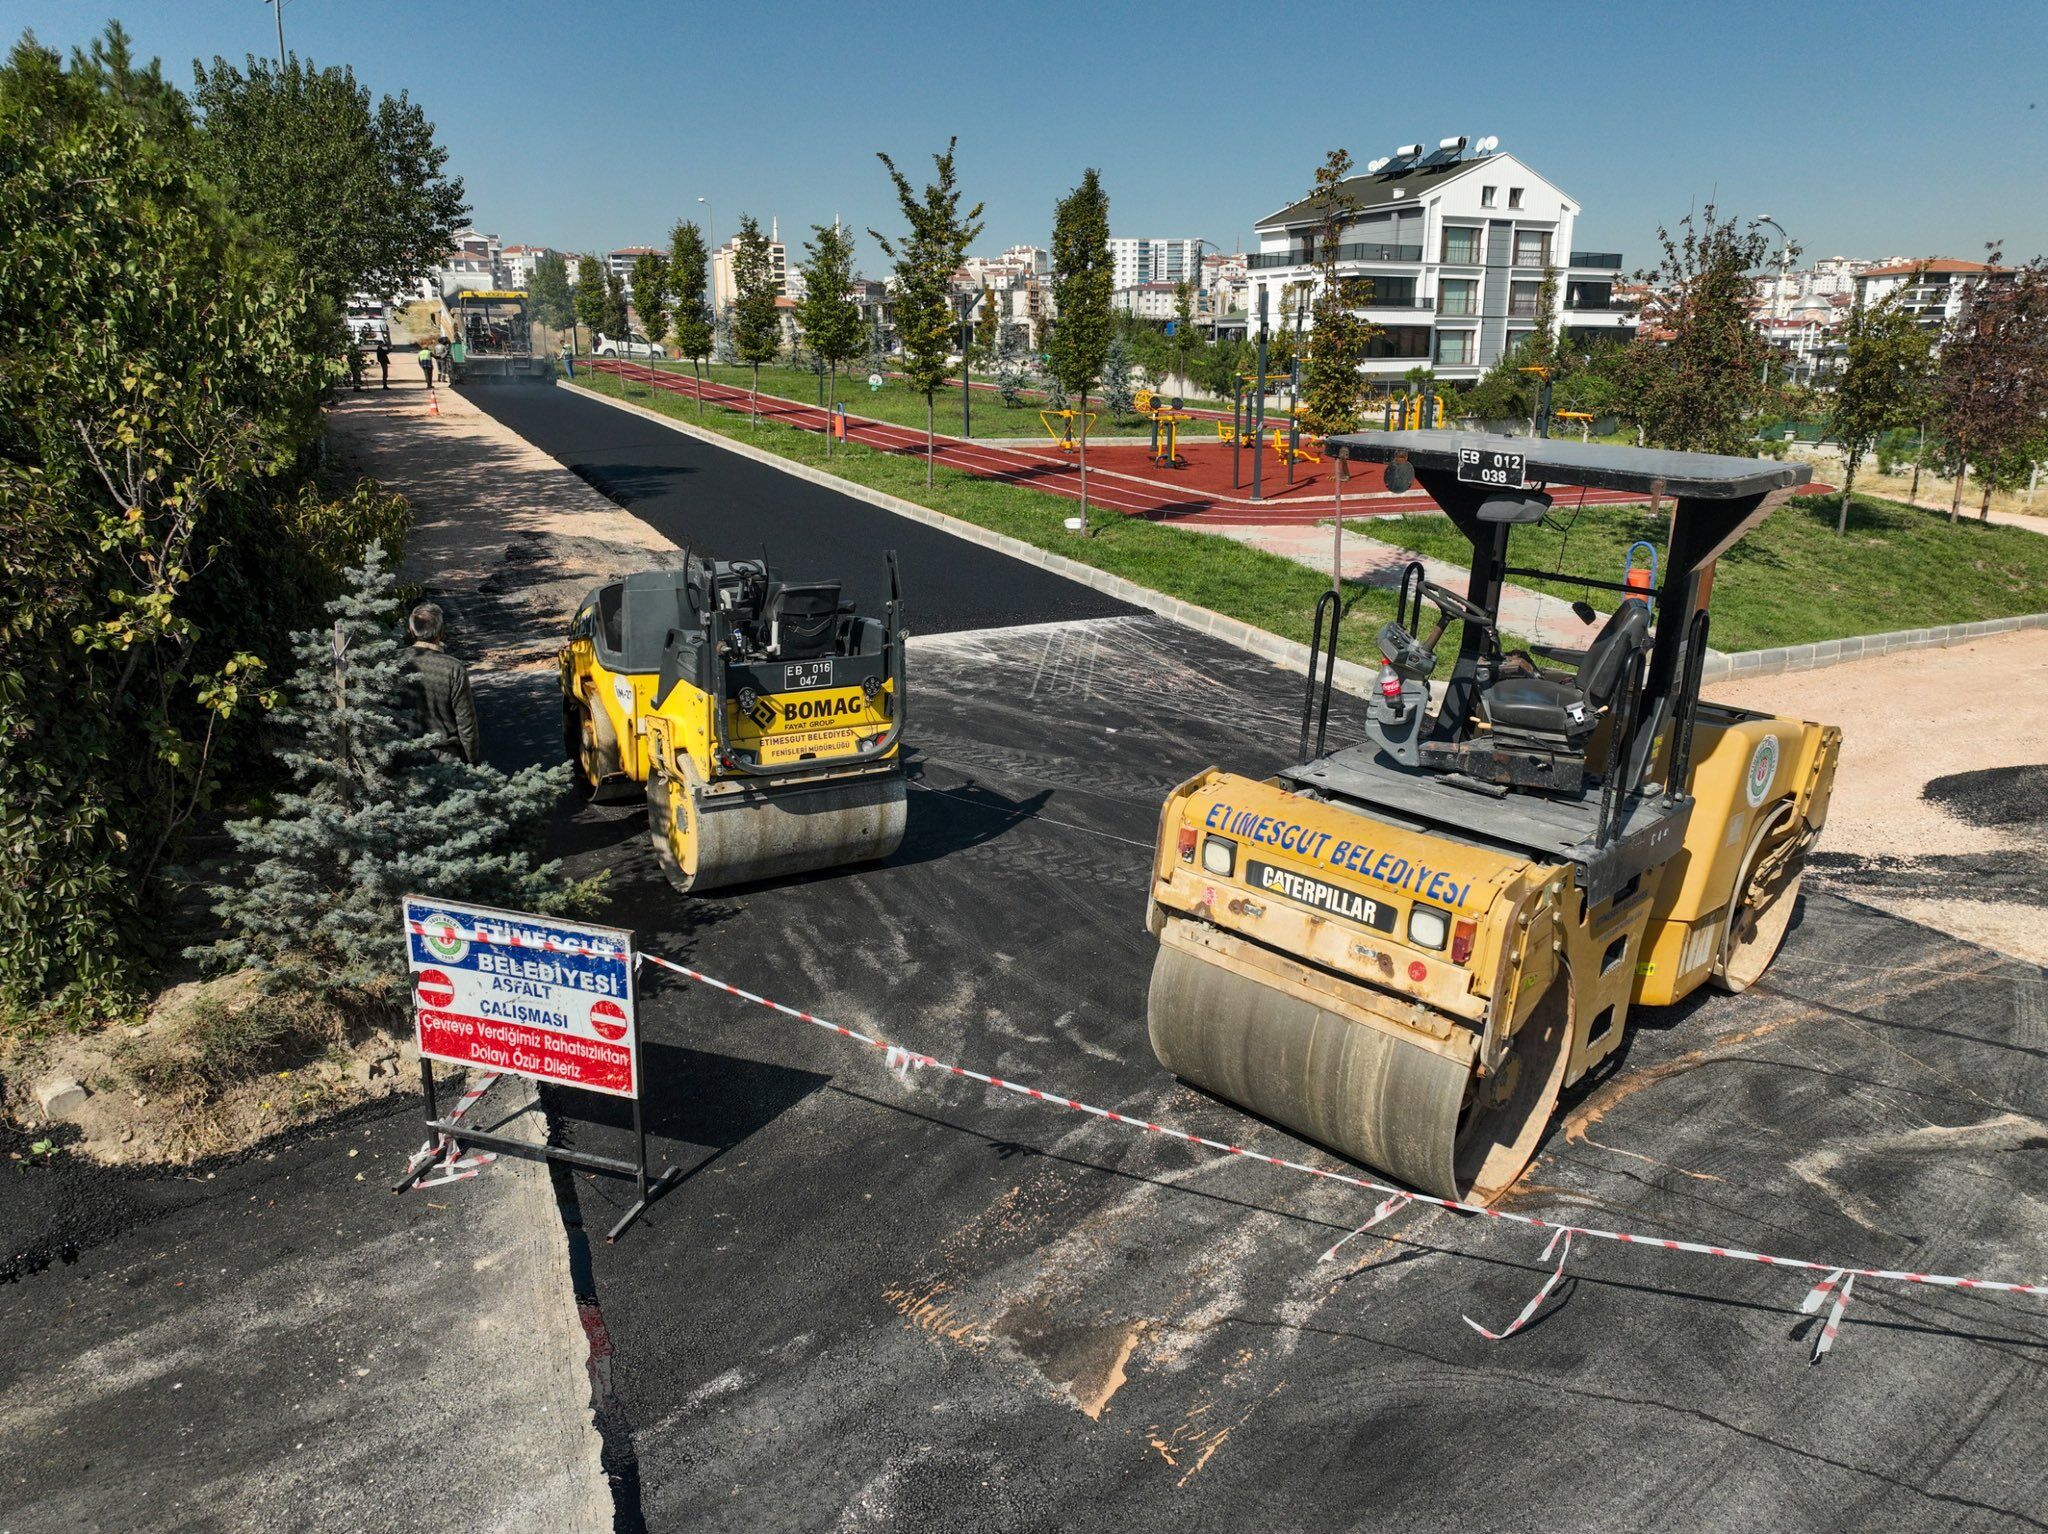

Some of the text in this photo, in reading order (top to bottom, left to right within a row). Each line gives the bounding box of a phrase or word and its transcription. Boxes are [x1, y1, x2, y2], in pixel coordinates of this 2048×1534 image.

[1461, 450, 1520, 469] EB 012
[1482, 469, 1507, 483] 038
[787, 663, 831, 676] EB 016
[800, 676, 818, 686] 047
[784, 696, 861, 721] BOMAG
[784, 719, 835, 730] FAYAT GROUP
[760, 734, 806, 747] ETİMESGUT
[1262, 866, 1378, 925] CATERPILLAR
[478, 952, 618, 996] BELEDİYESİ
[492, 976, 551, 1000] ASFALT
[480, 999, 568, 1029] ÇALIŞMASI
[422, 1013, 630, 1067] Çevreye Verdiğimiz Rahatsızlıktan
[471, 1042, 581, 1078] Dolayı Özür Dileriz
